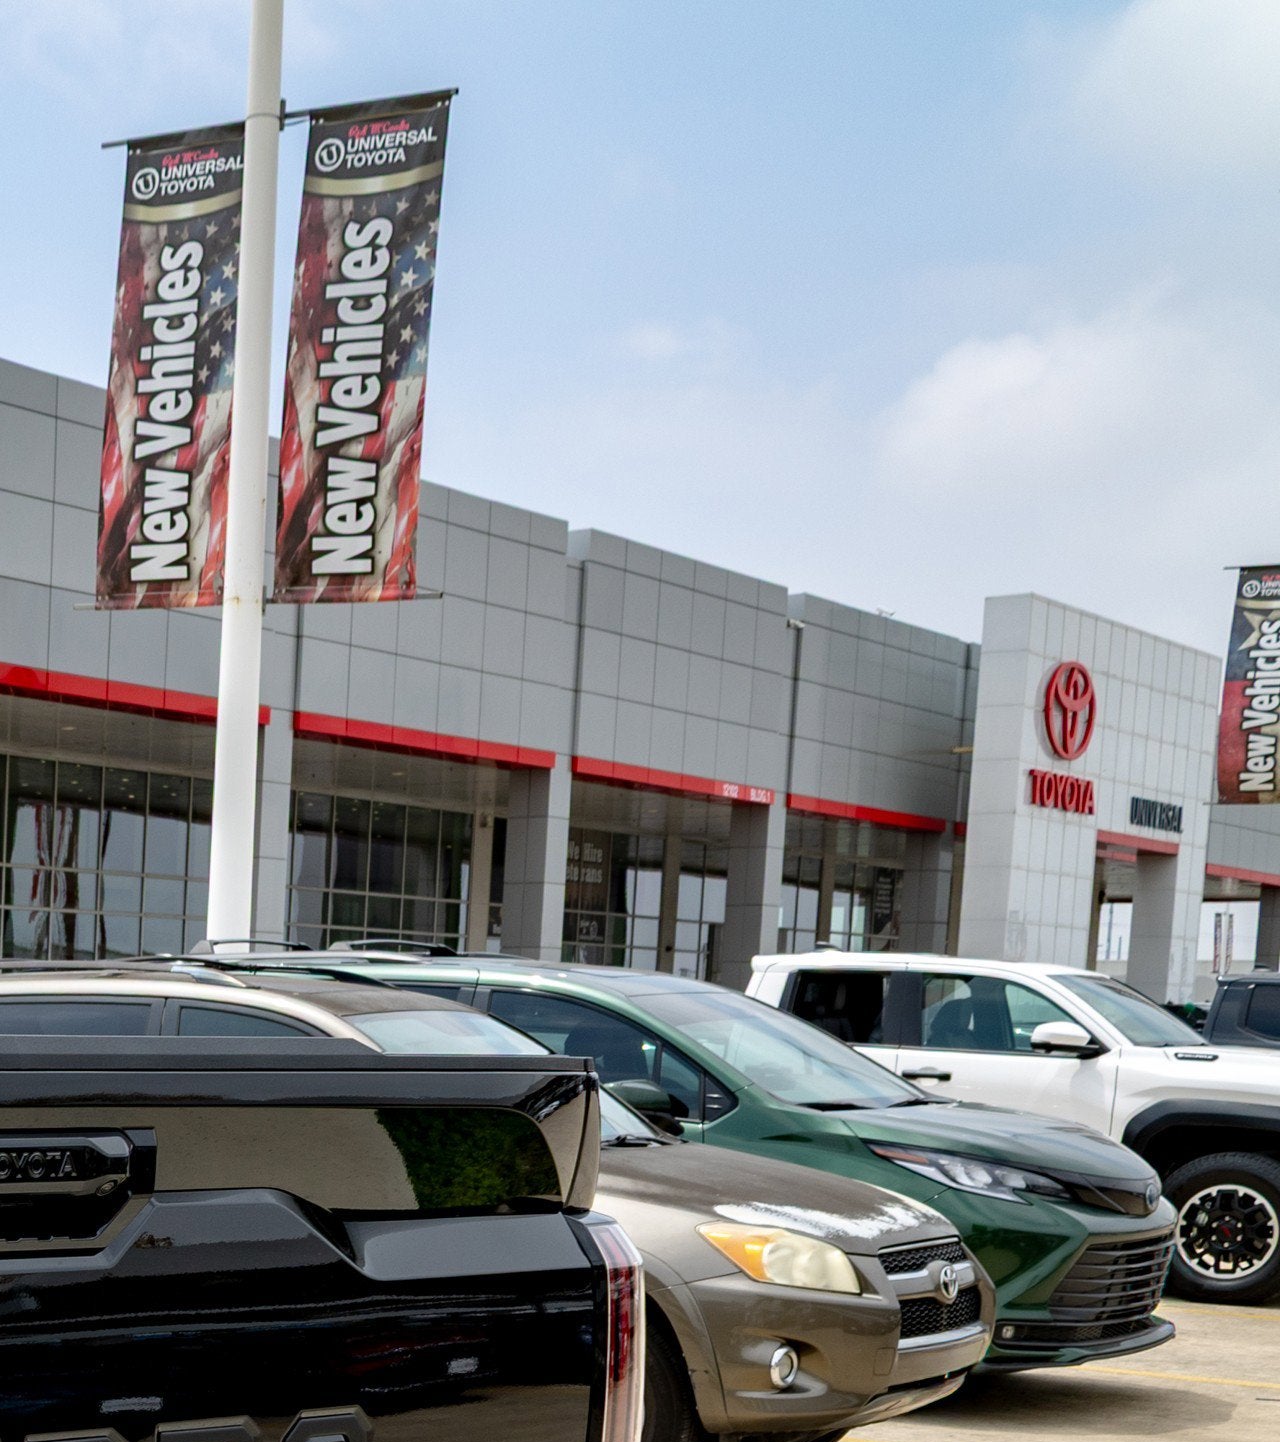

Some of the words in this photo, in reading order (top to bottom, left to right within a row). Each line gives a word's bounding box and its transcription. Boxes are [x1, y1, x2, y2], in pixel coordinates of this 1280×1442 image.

[160, 155, 244, 181] UNIVERSAL
[345, 147, 406, 170] TOYOTA
[346, 126, 438, 153] UNIVERSAL
[159, 174, 215, 197] TOYOTA
[134, 240, 204, 460] Vehicles
[315, 216, 393, 448] Vehicles
[130, 468, 189, 582] New
[311, 456, 379, 577] New
[1242, 620, 1280, 730] Vehicles
[1029, 769, 1094, 815] TOYOTA
[1239, 734, 1278, 793] New
